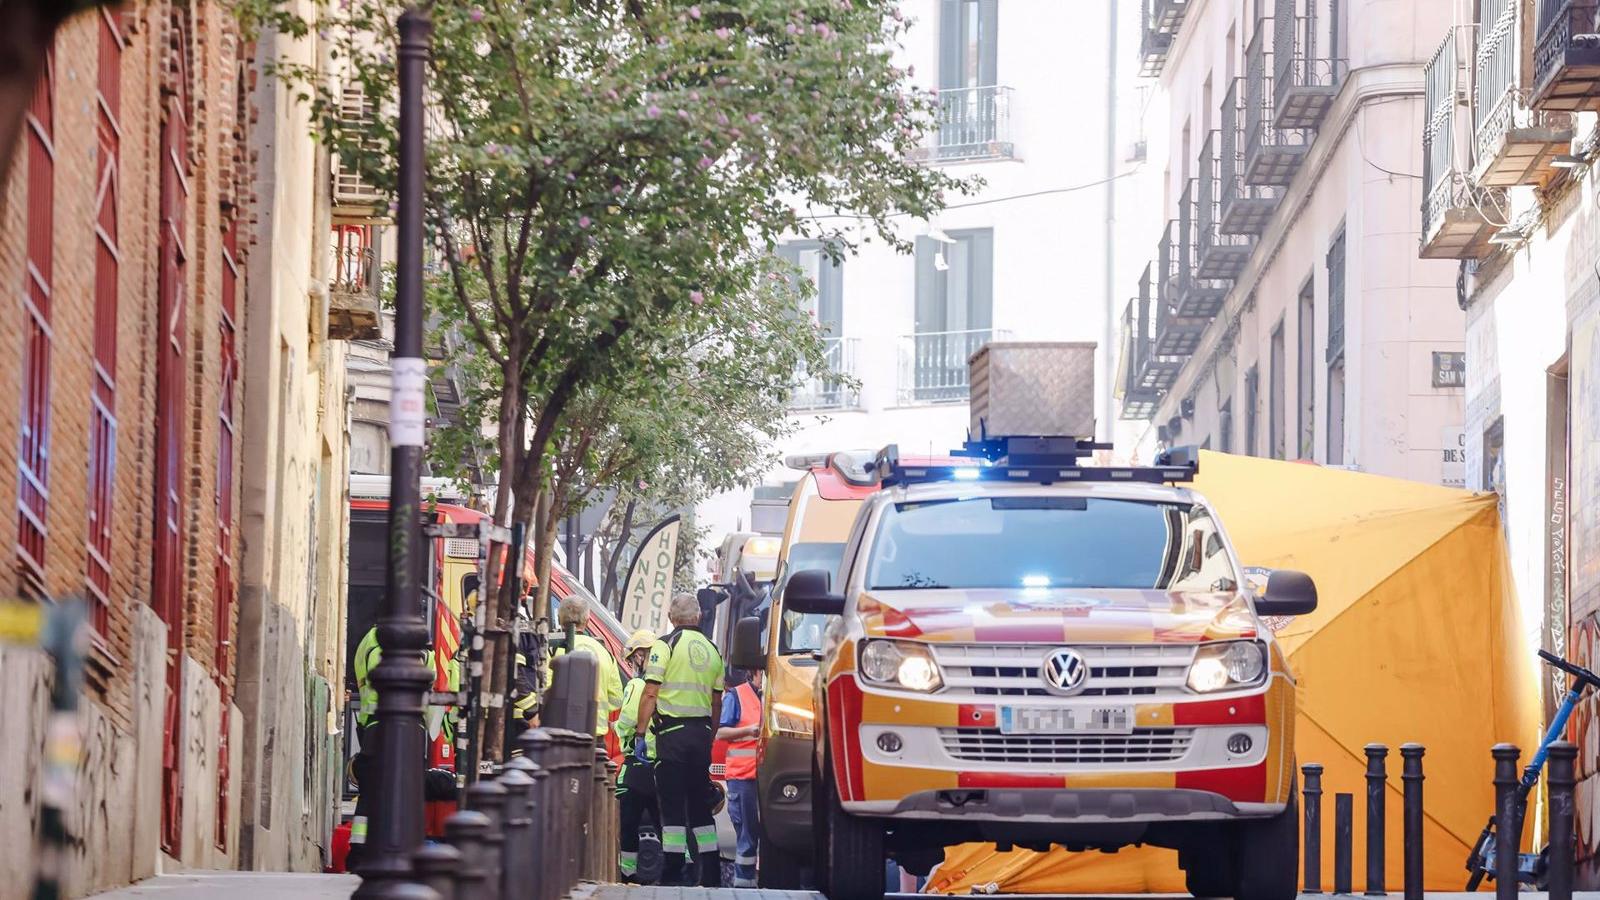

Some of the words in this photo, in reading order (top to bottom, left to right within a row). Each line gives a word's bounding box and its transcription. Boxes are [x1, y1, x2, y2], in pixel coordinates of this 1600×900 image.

[1440, 371, 1456, 384] SAN
[1443, 449, 1458, 463] DE
[630, 558, 650, 633] NATU
[651, 531, 671, 632] HORCH
